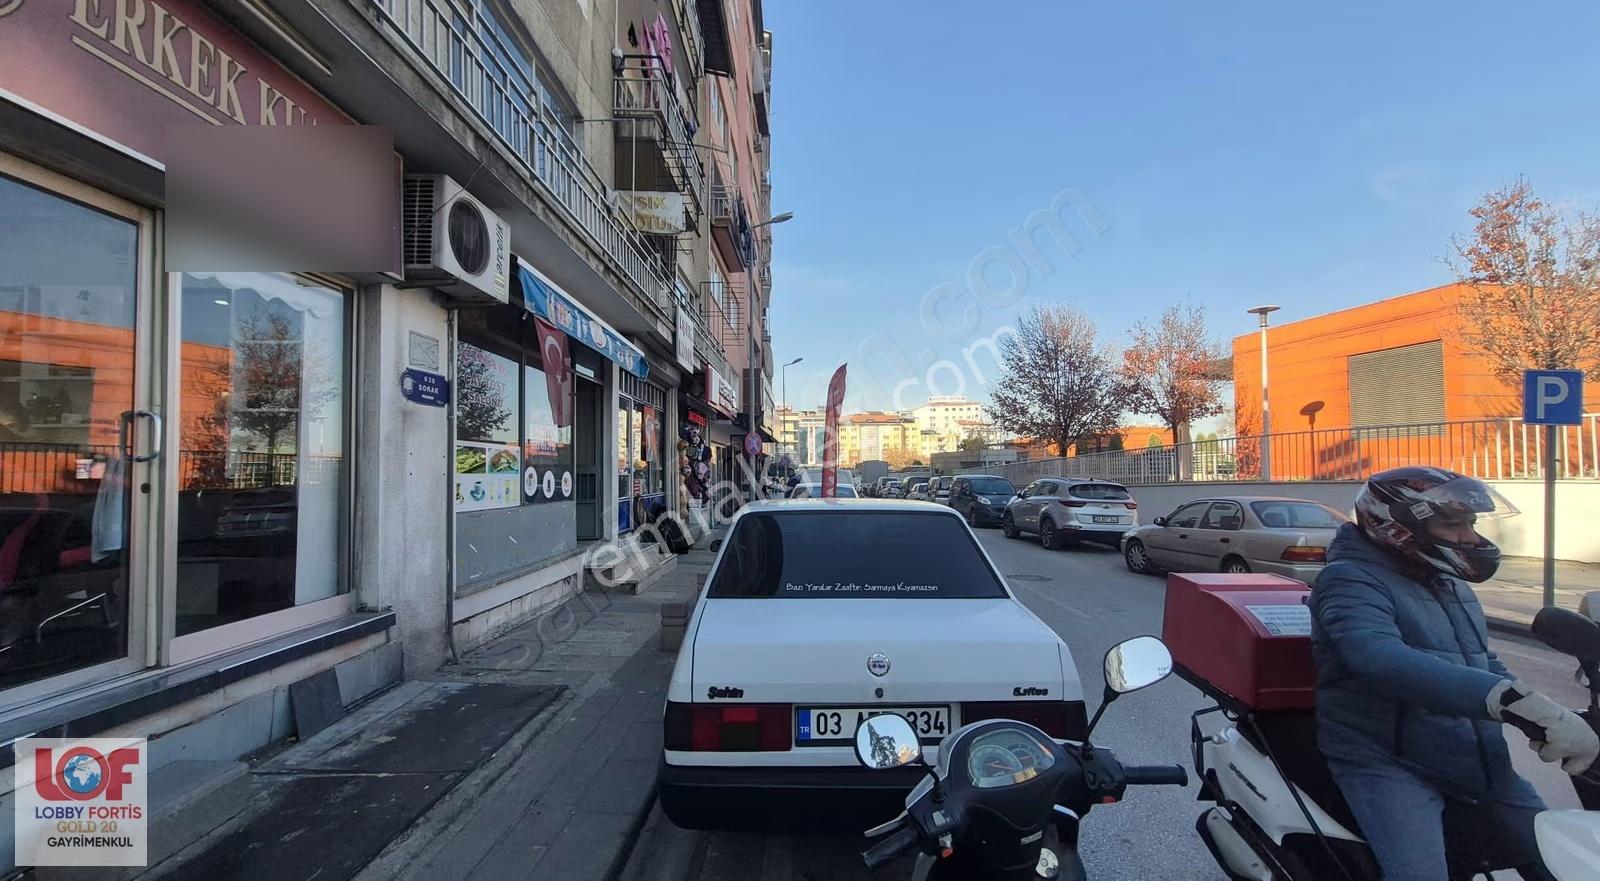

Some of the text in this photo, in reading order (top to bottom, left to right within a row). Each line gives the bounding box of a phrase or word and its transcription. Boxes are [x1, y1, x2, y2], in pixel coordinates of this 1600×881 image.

[67, 0, 248, 126] ERKEK
[418, 384, 440, 394] SOKAK
[1536, 376, 1569, 419] P
[805, 582, 833, 592] Yaralar
[864, 582, 896, 592] Sarmaya
[800, 726, 810, 734] TR
[816, 712, 842, 736] 03
